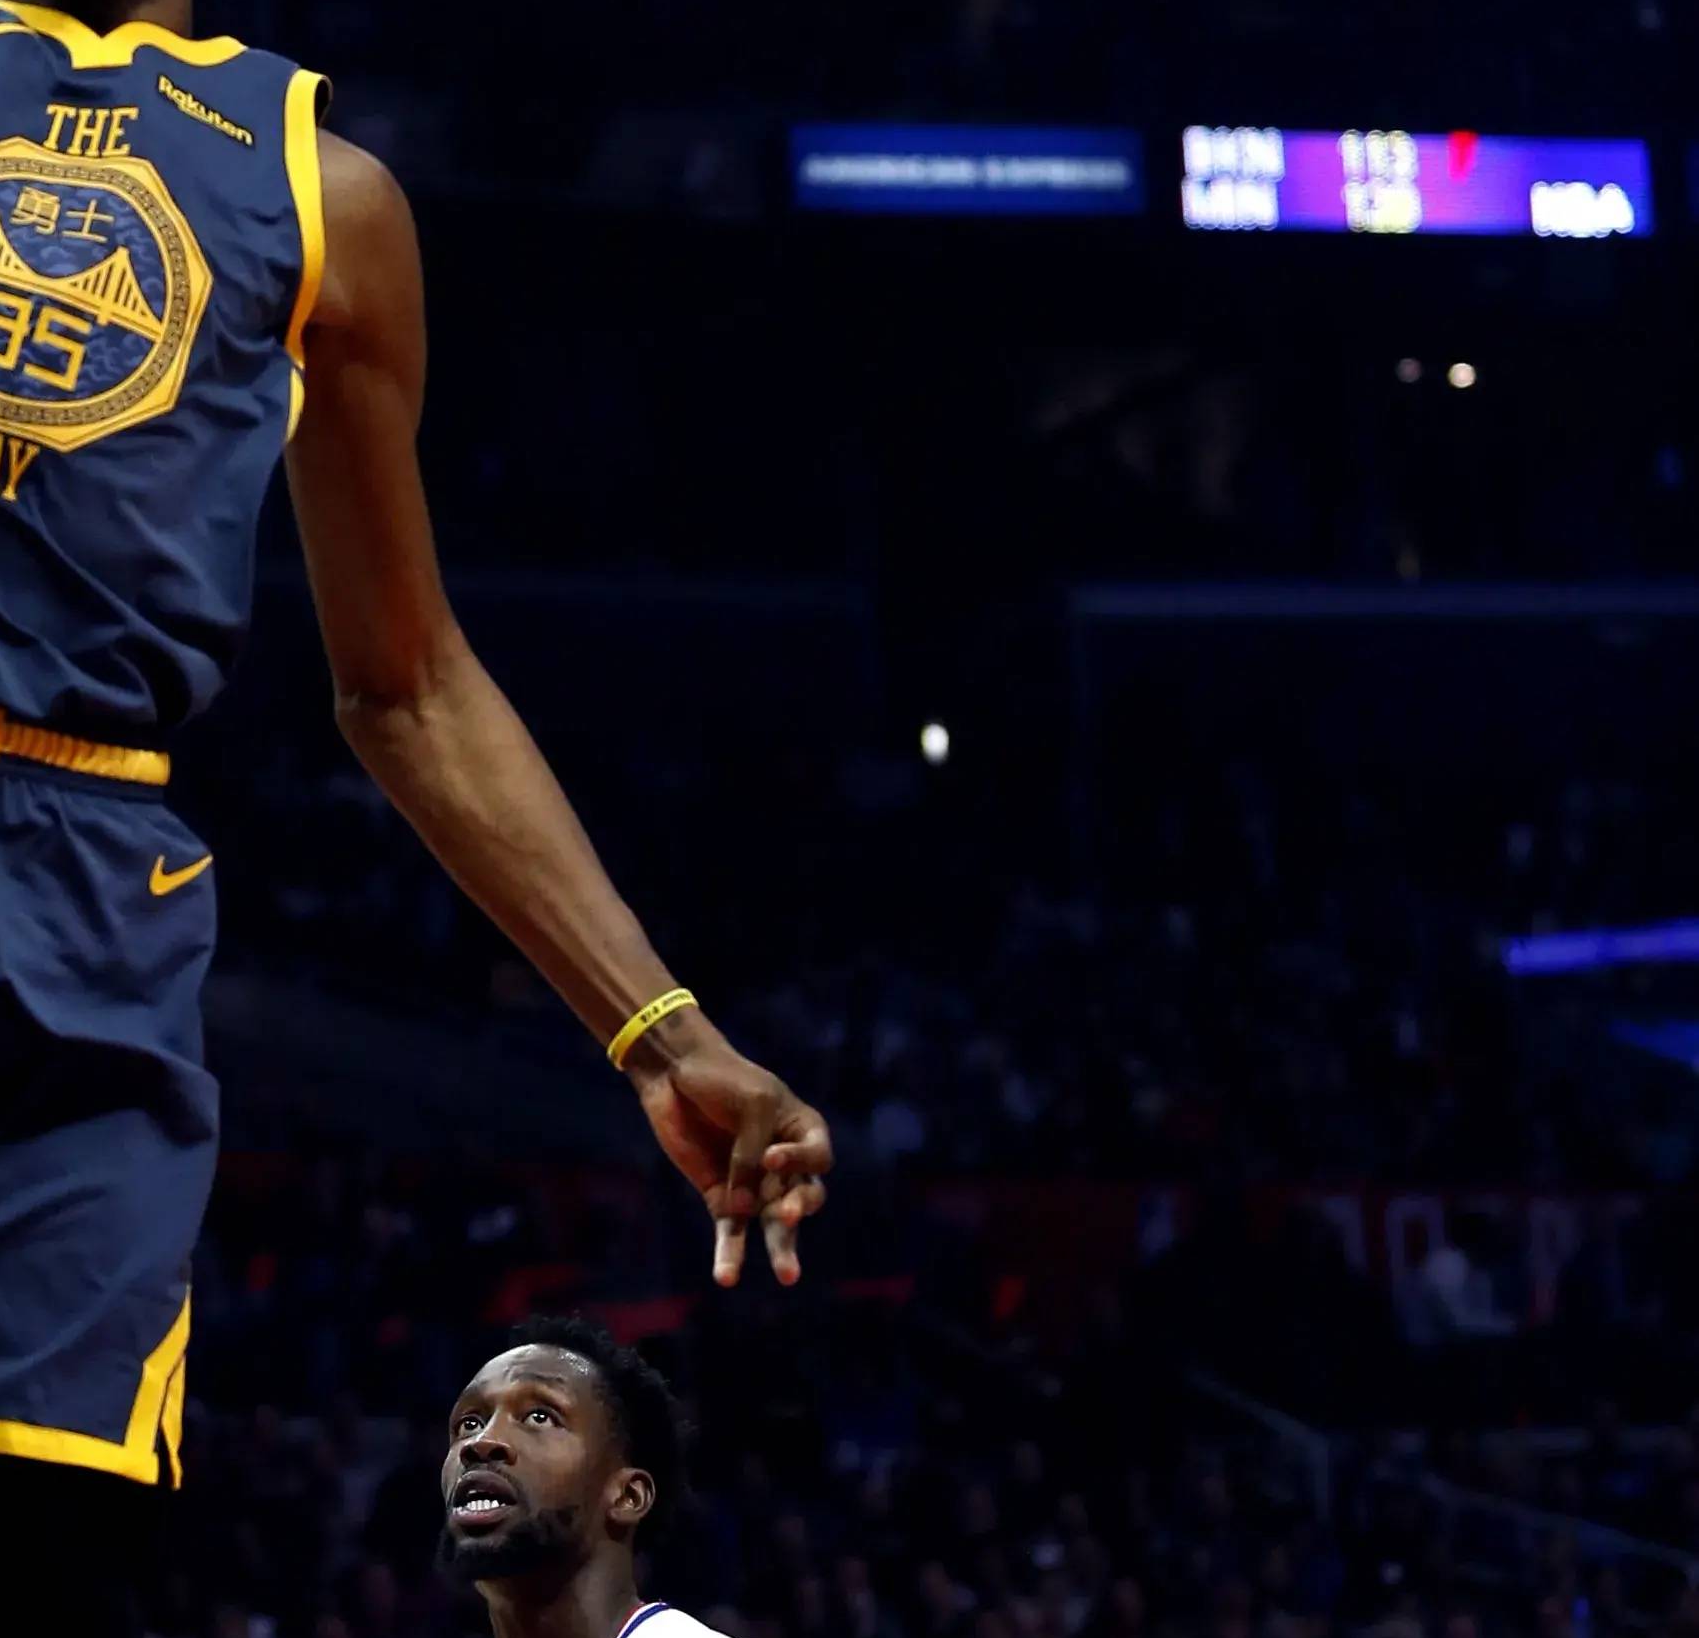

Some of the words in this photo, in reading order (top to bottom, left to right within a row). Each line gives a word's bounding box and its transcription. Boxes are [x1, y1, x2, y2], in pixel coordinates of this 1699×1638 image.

[42, 103, 138, 158] THE
[158, 74, 254, 146] Rakuten
[9, 185, 115, 244] 勇士
